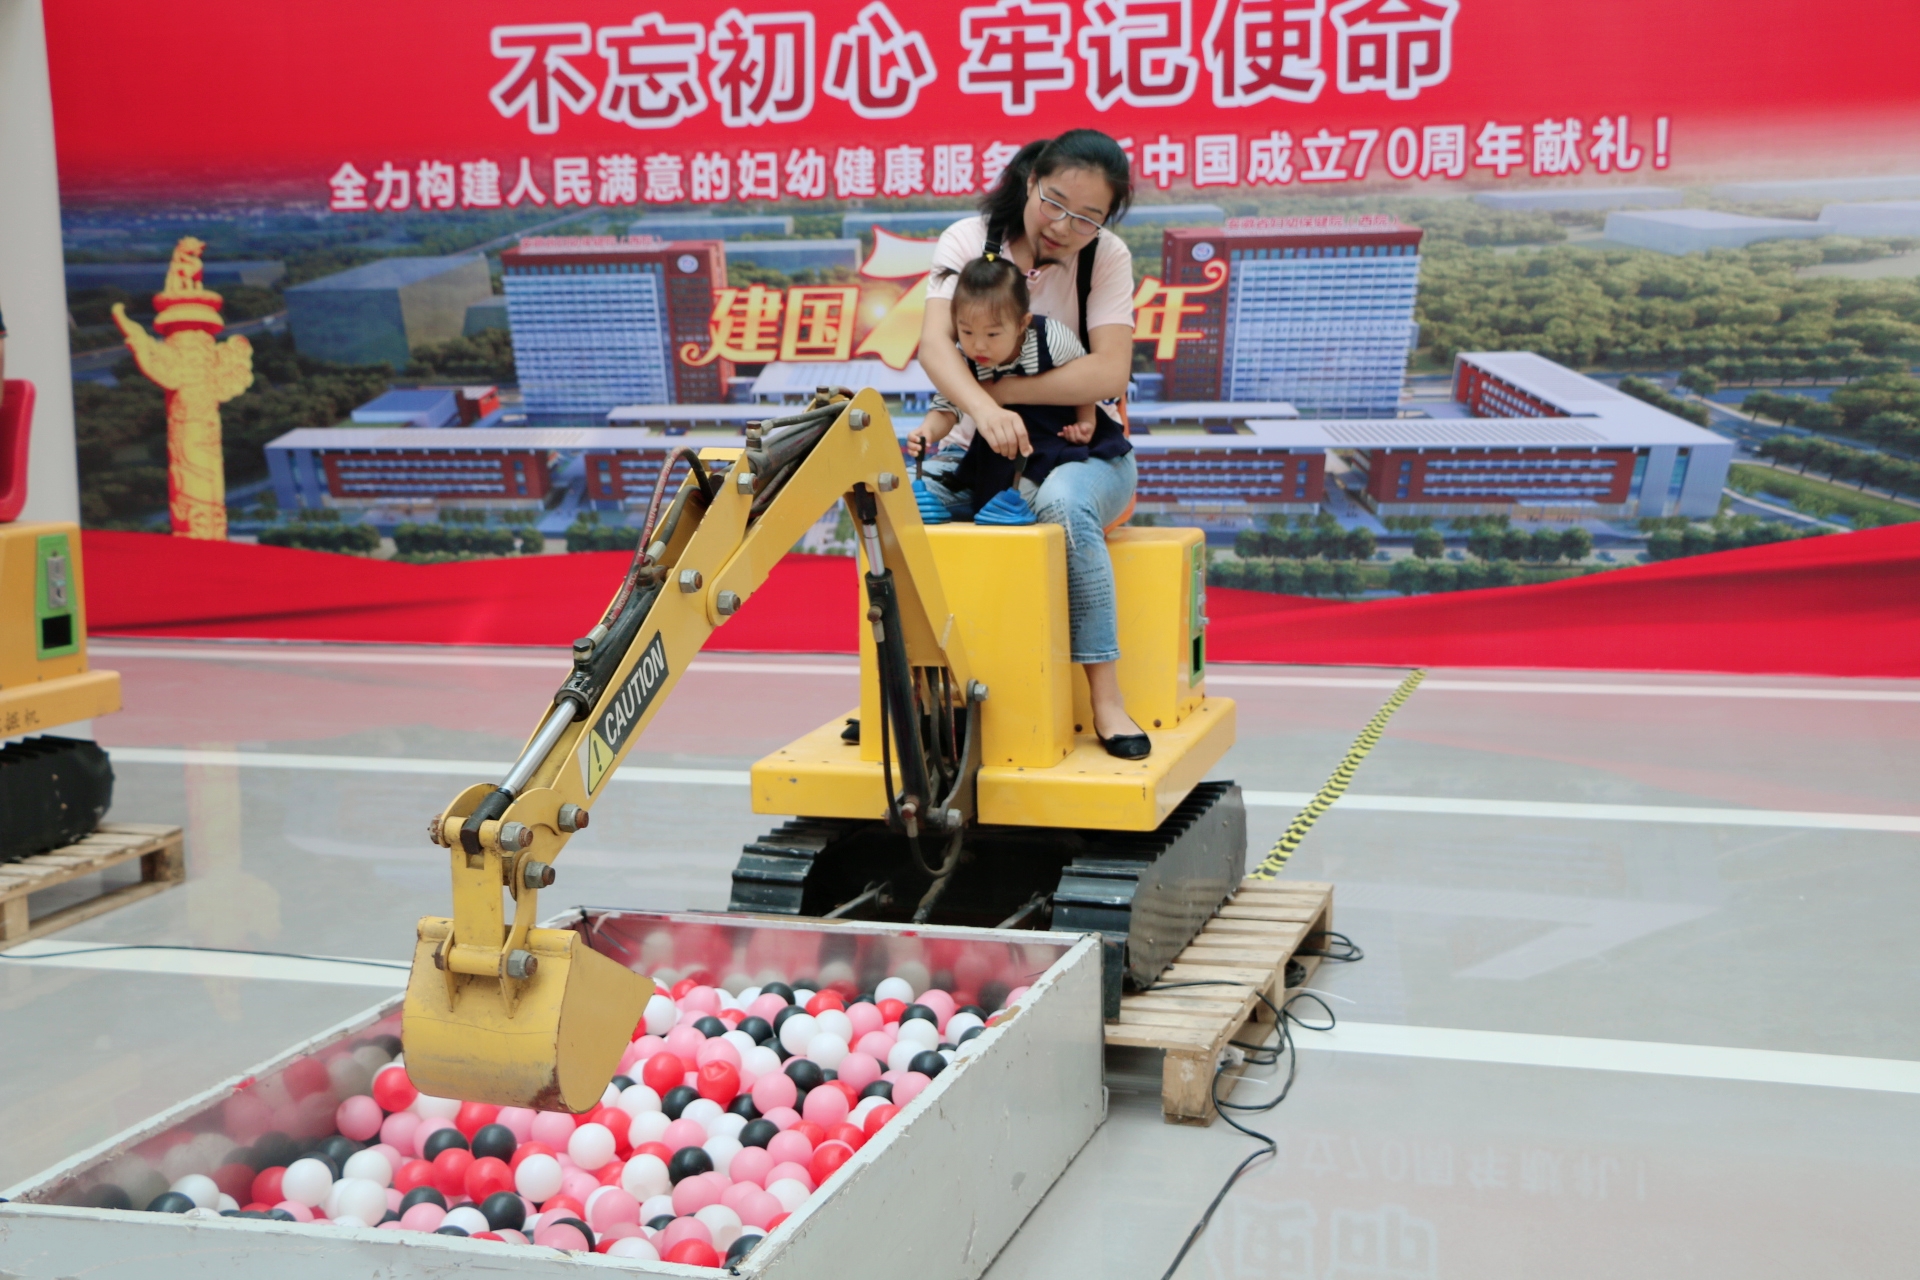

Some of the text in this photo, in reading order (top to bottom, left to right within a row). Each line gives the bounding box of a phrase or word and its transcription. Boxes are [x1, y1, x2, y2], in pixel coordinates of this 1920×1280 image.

[490, 0, 1456, 134] 不忘初心 牢记使命
[605, 639, 665, 746] CAUTION
